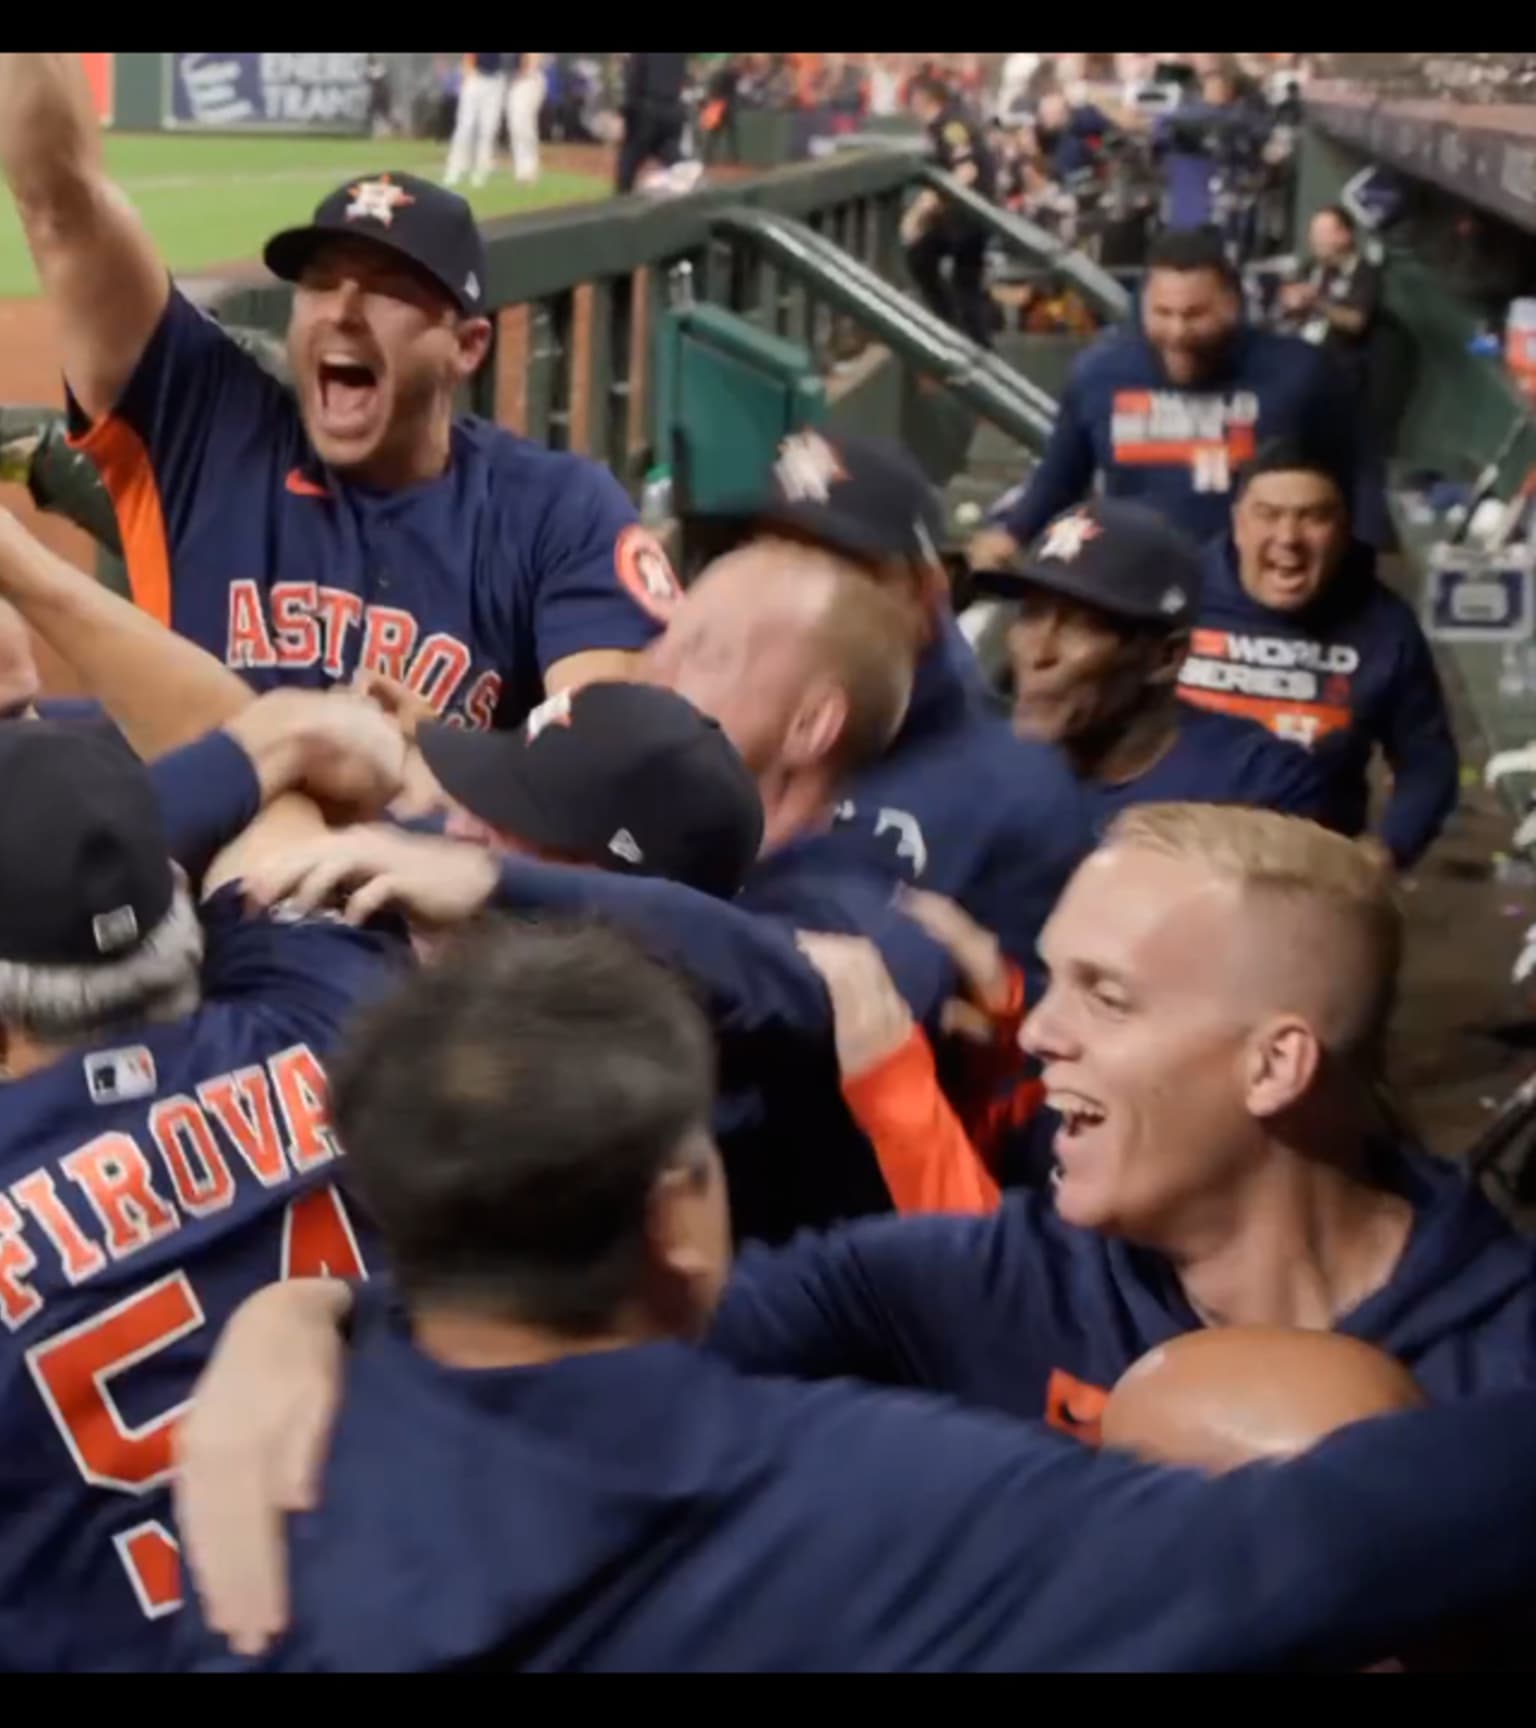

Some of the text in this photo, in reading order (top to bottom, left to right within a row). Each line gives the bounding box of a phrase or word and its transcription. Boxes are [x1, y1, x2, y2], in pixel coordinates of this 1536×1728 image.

[227, 578, 502, 732] ASTROS
[1227, 632, 1361, 676] WORLD
[1177, 656, 1318, 701] SERIES
